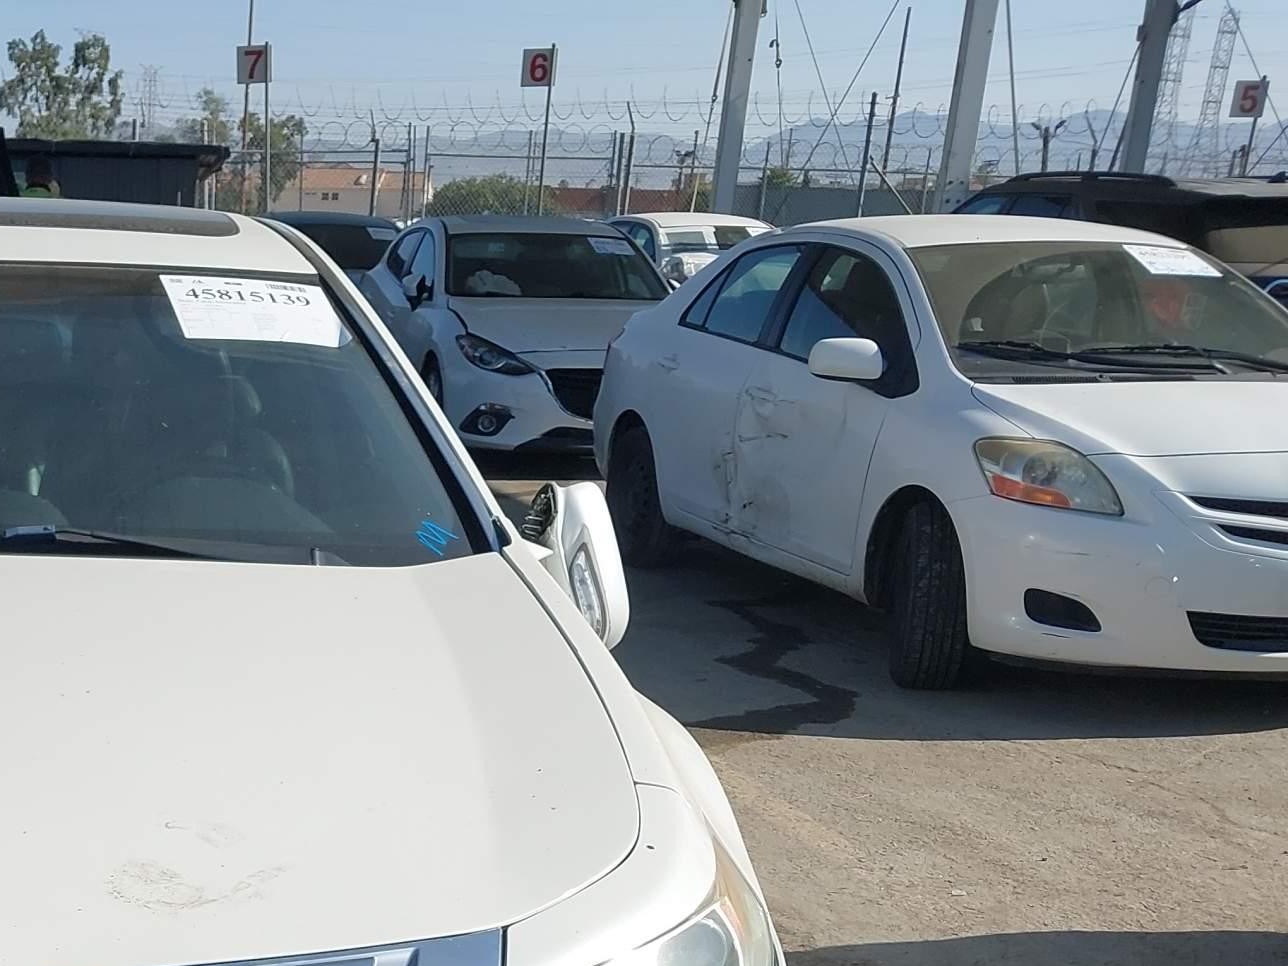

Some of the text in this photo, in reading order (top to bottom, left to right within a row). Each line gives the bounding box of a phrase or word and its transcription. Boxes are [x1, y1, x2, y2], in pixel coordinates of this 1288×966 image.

[244, 50, 264, 79] 7
[529, 52, 548, 82] 6
[1239, 85, 1260, 113] 5
[185, 287, 312, 307] 45815139
